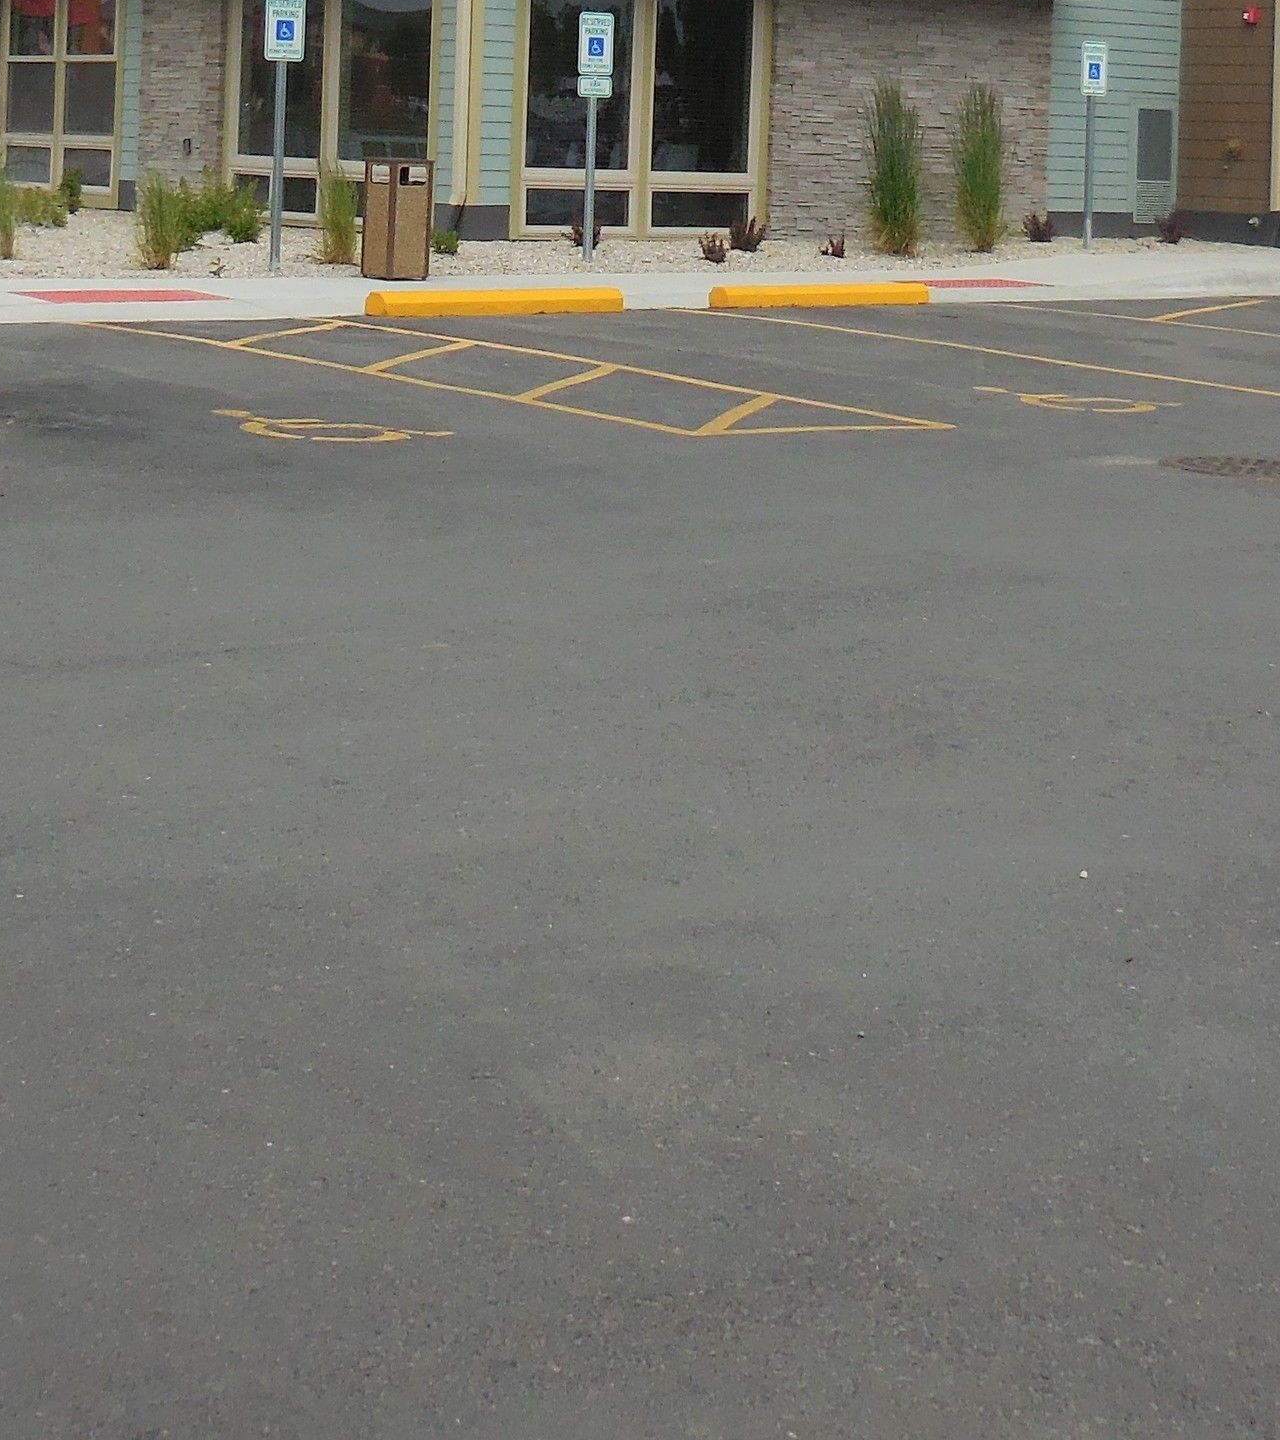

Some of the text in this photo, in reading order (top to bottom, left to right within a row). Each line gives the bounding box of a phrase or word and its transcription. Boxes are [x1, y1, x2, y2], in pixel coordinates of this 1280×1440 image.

[272, 10, 300, 19] PARKING
[582, 17, 612, 27] RESERVED
[584, 27, 609, 36] PARKING
